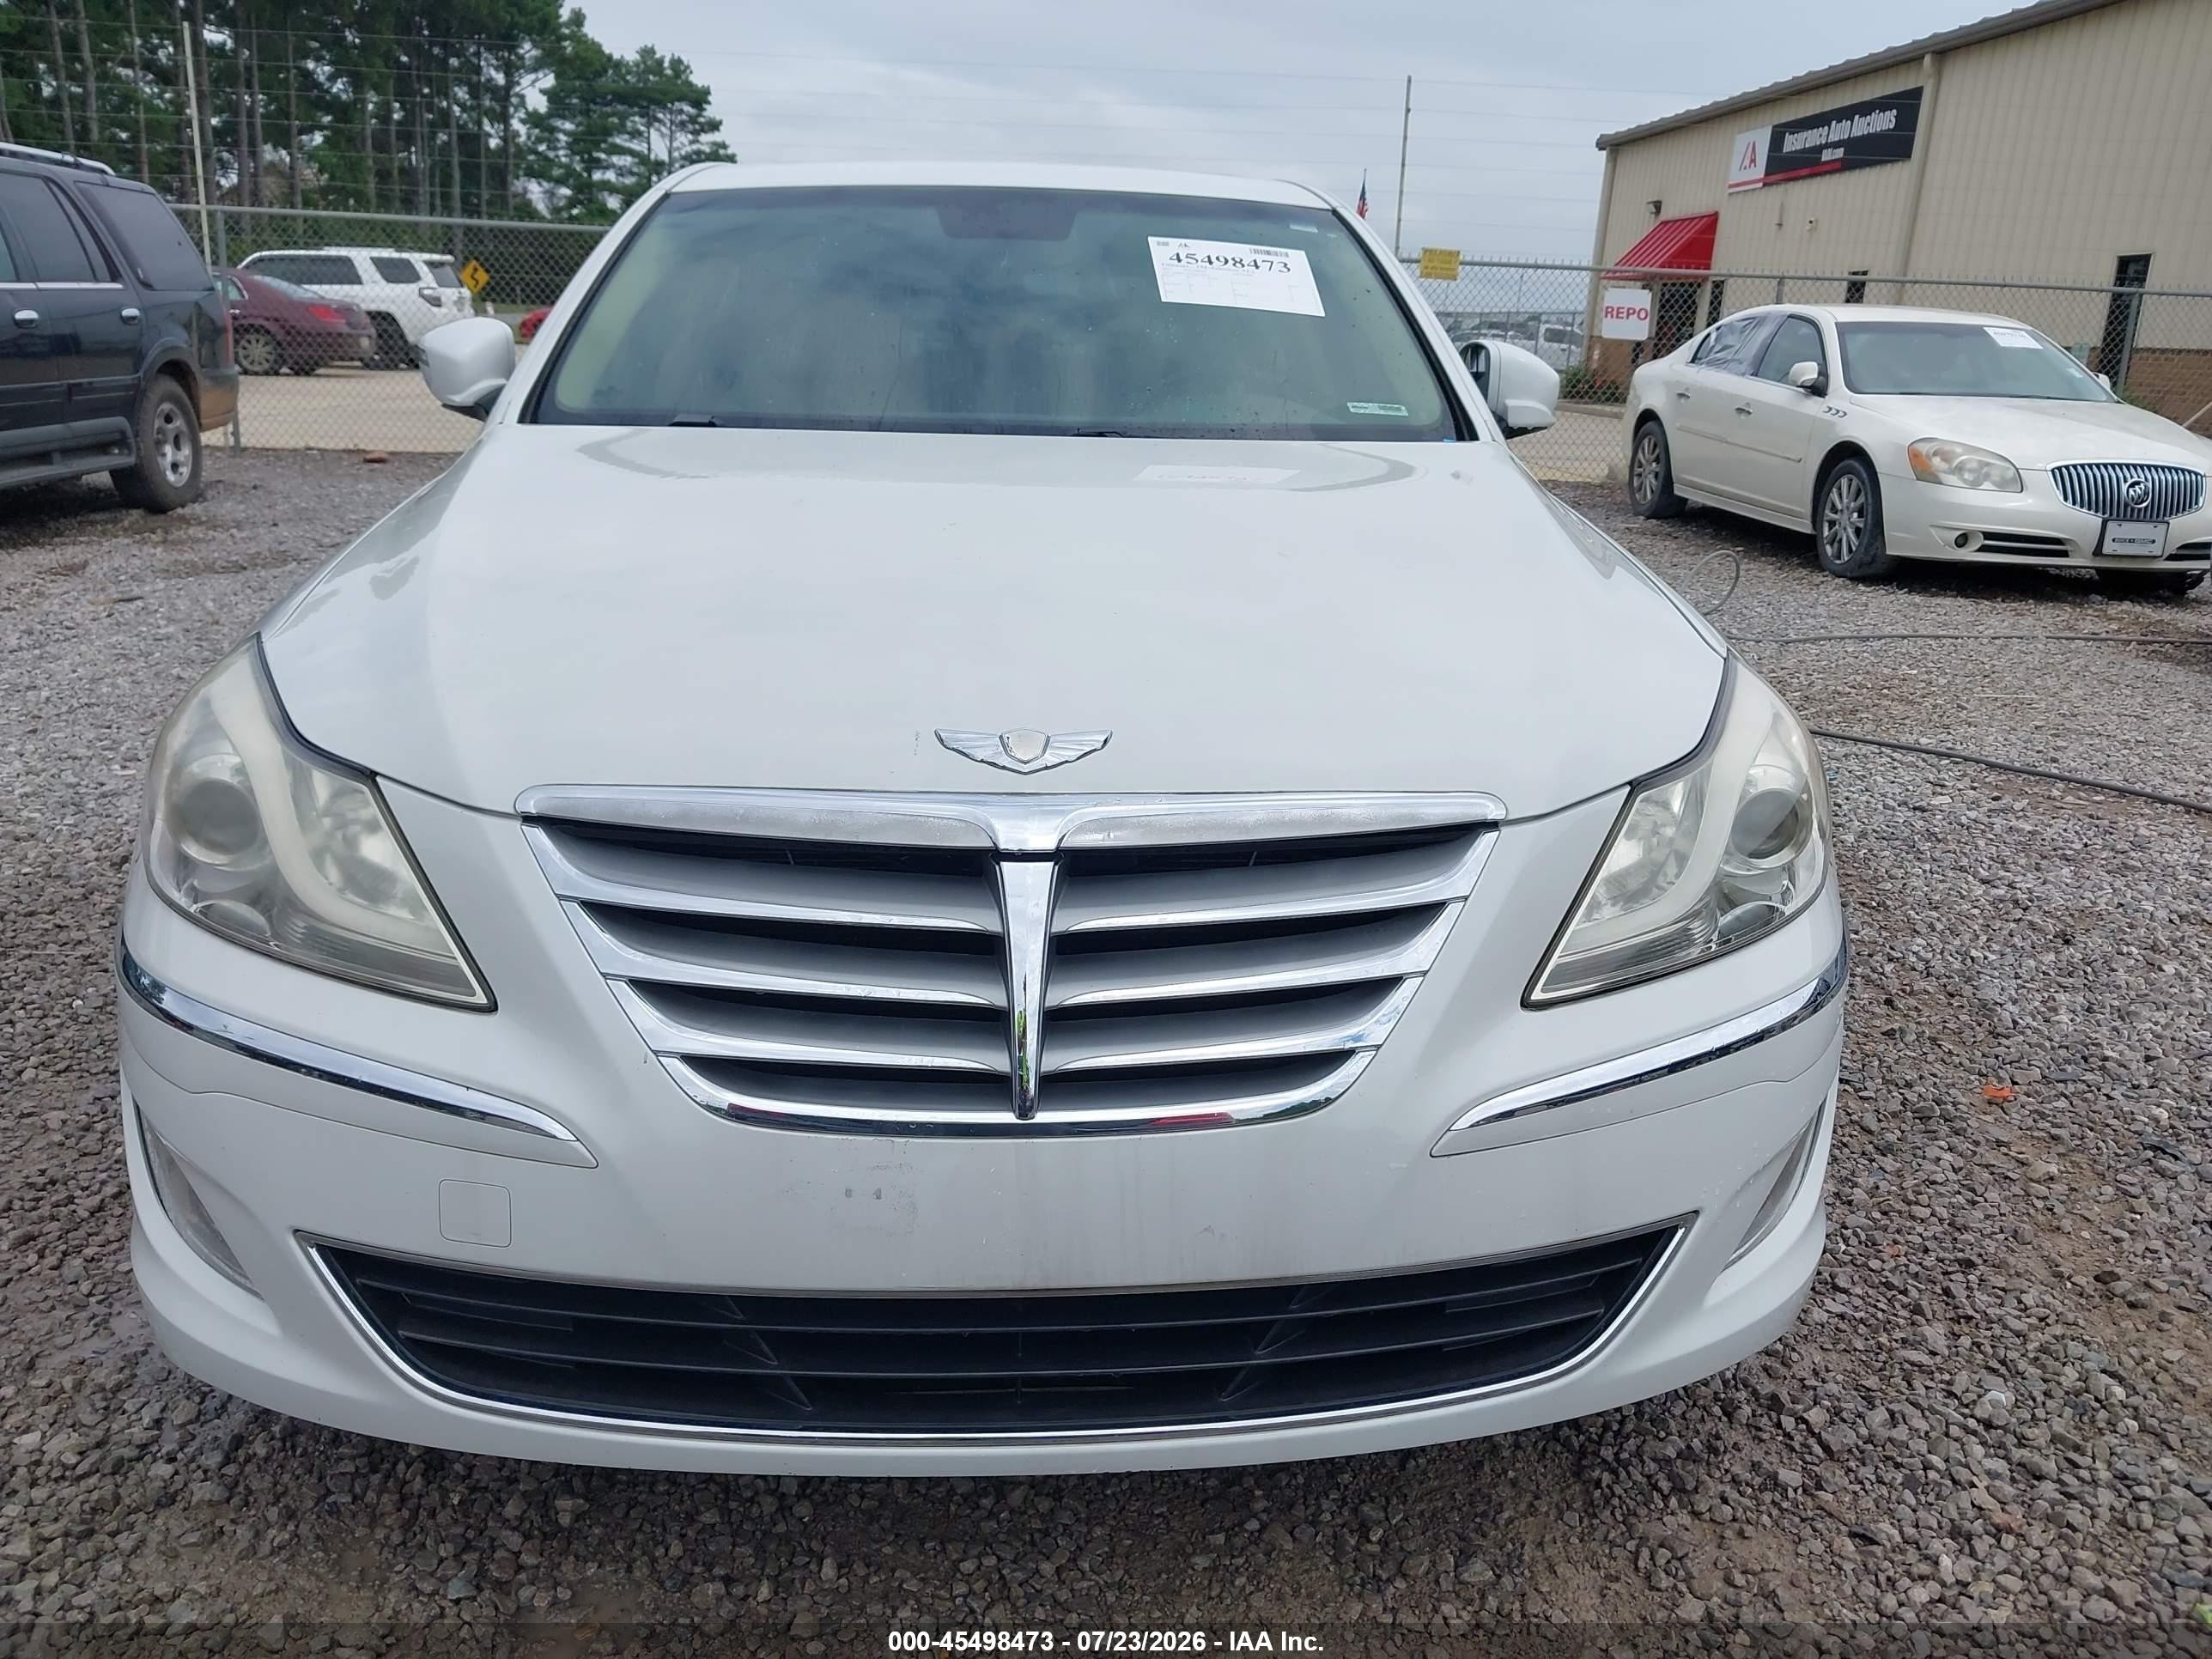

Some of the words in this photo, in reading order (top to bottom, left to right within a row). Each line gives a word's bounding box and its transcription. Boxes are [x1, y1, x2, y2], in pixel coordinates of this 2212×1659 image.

[1784, 125, 1828, 153] Insurance
[1828, 119, 1850, 143] Auto
[1850, 108, 1897, 137] Auctions
[1169, 252, 1291, 273] 45498473
[1604, 306, 1649, 320] REPO
